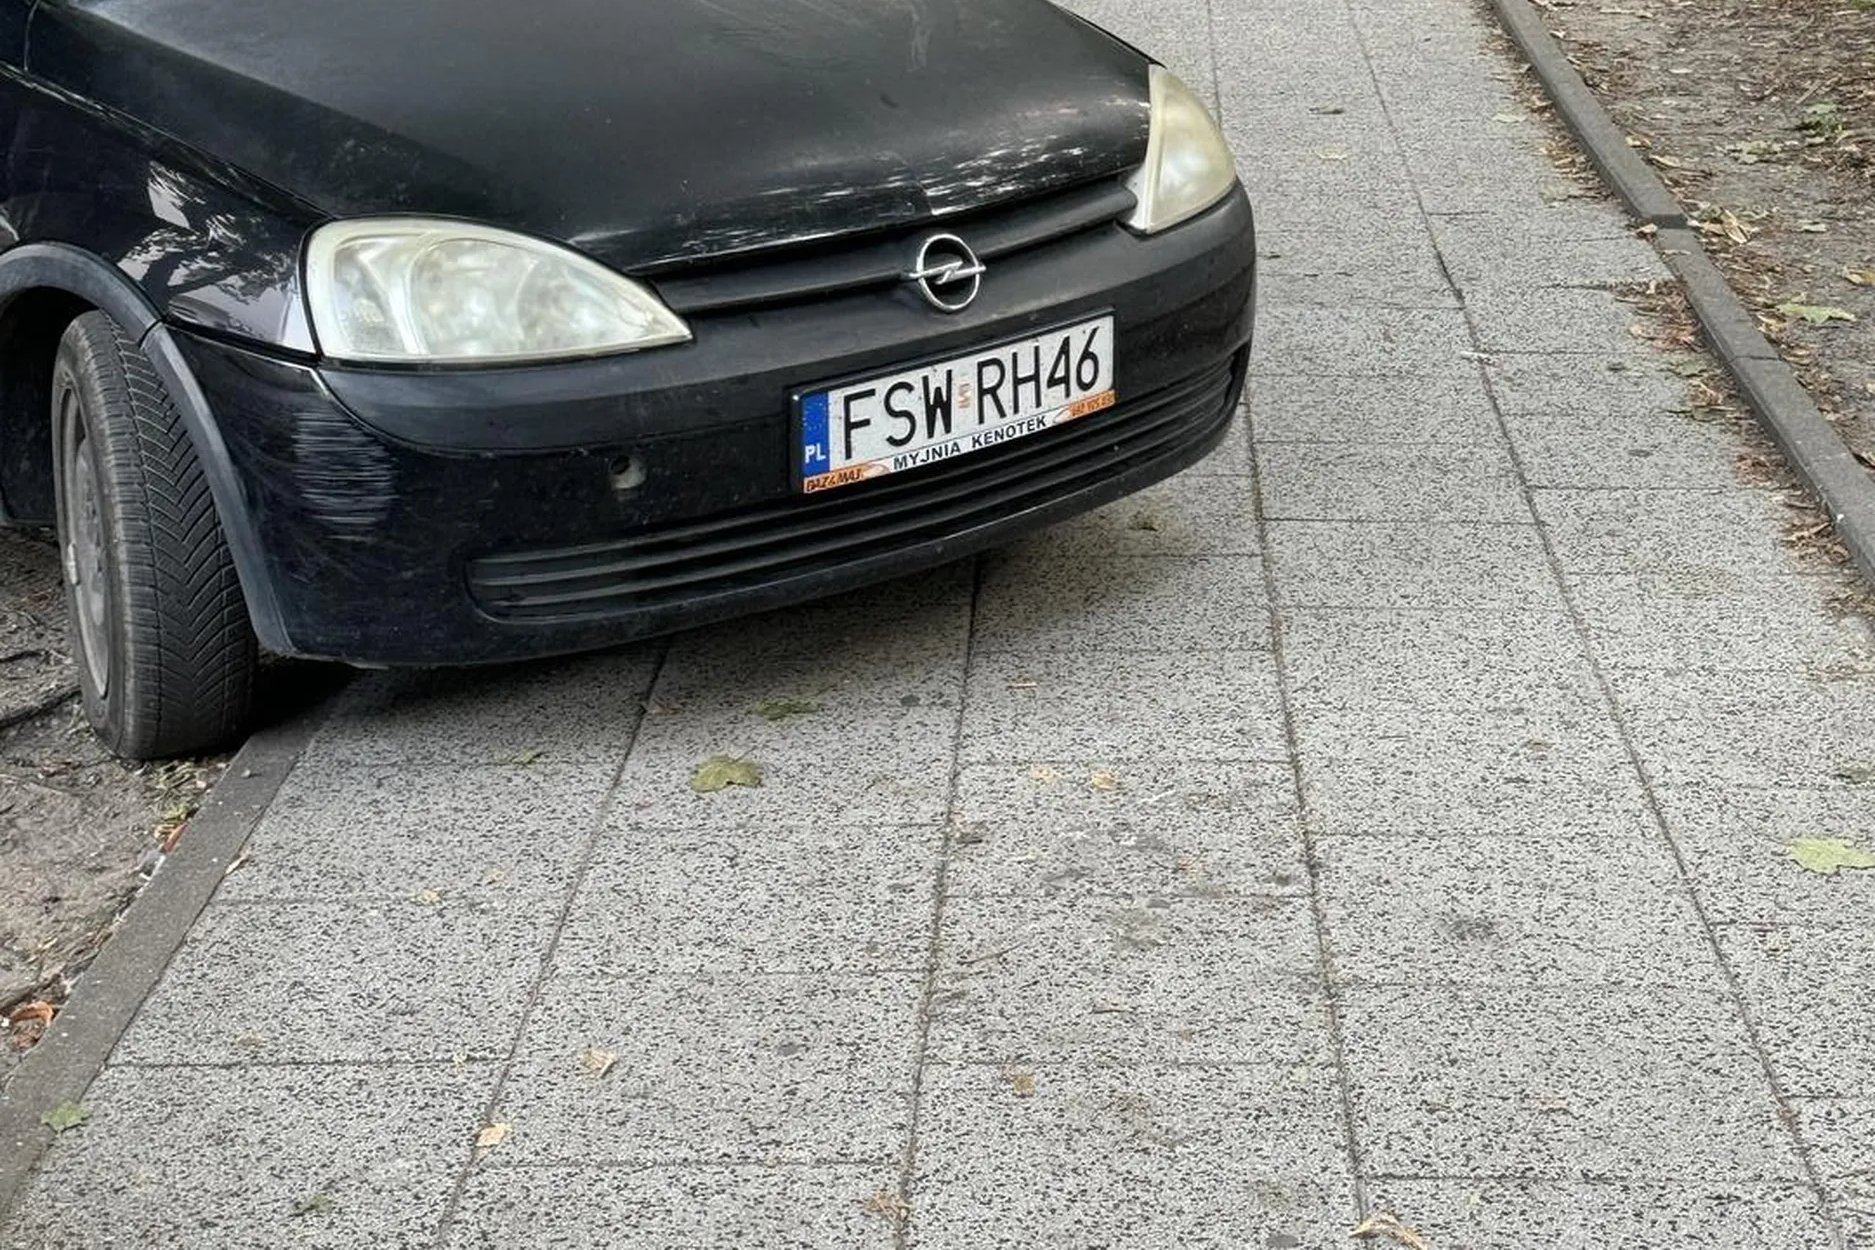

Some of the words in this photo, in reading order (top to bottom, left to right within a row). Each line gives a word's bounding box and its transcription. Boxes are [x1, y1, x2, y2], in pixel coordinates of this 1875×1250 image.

[843, 368, 952, 460] FSW
[976, 325, 1100, 425] RH46
[804, 442, 826, 464] PL
[893, 441, 961, 470] MYJNIA
[971, 415, 1047, 449] KENOTEK
